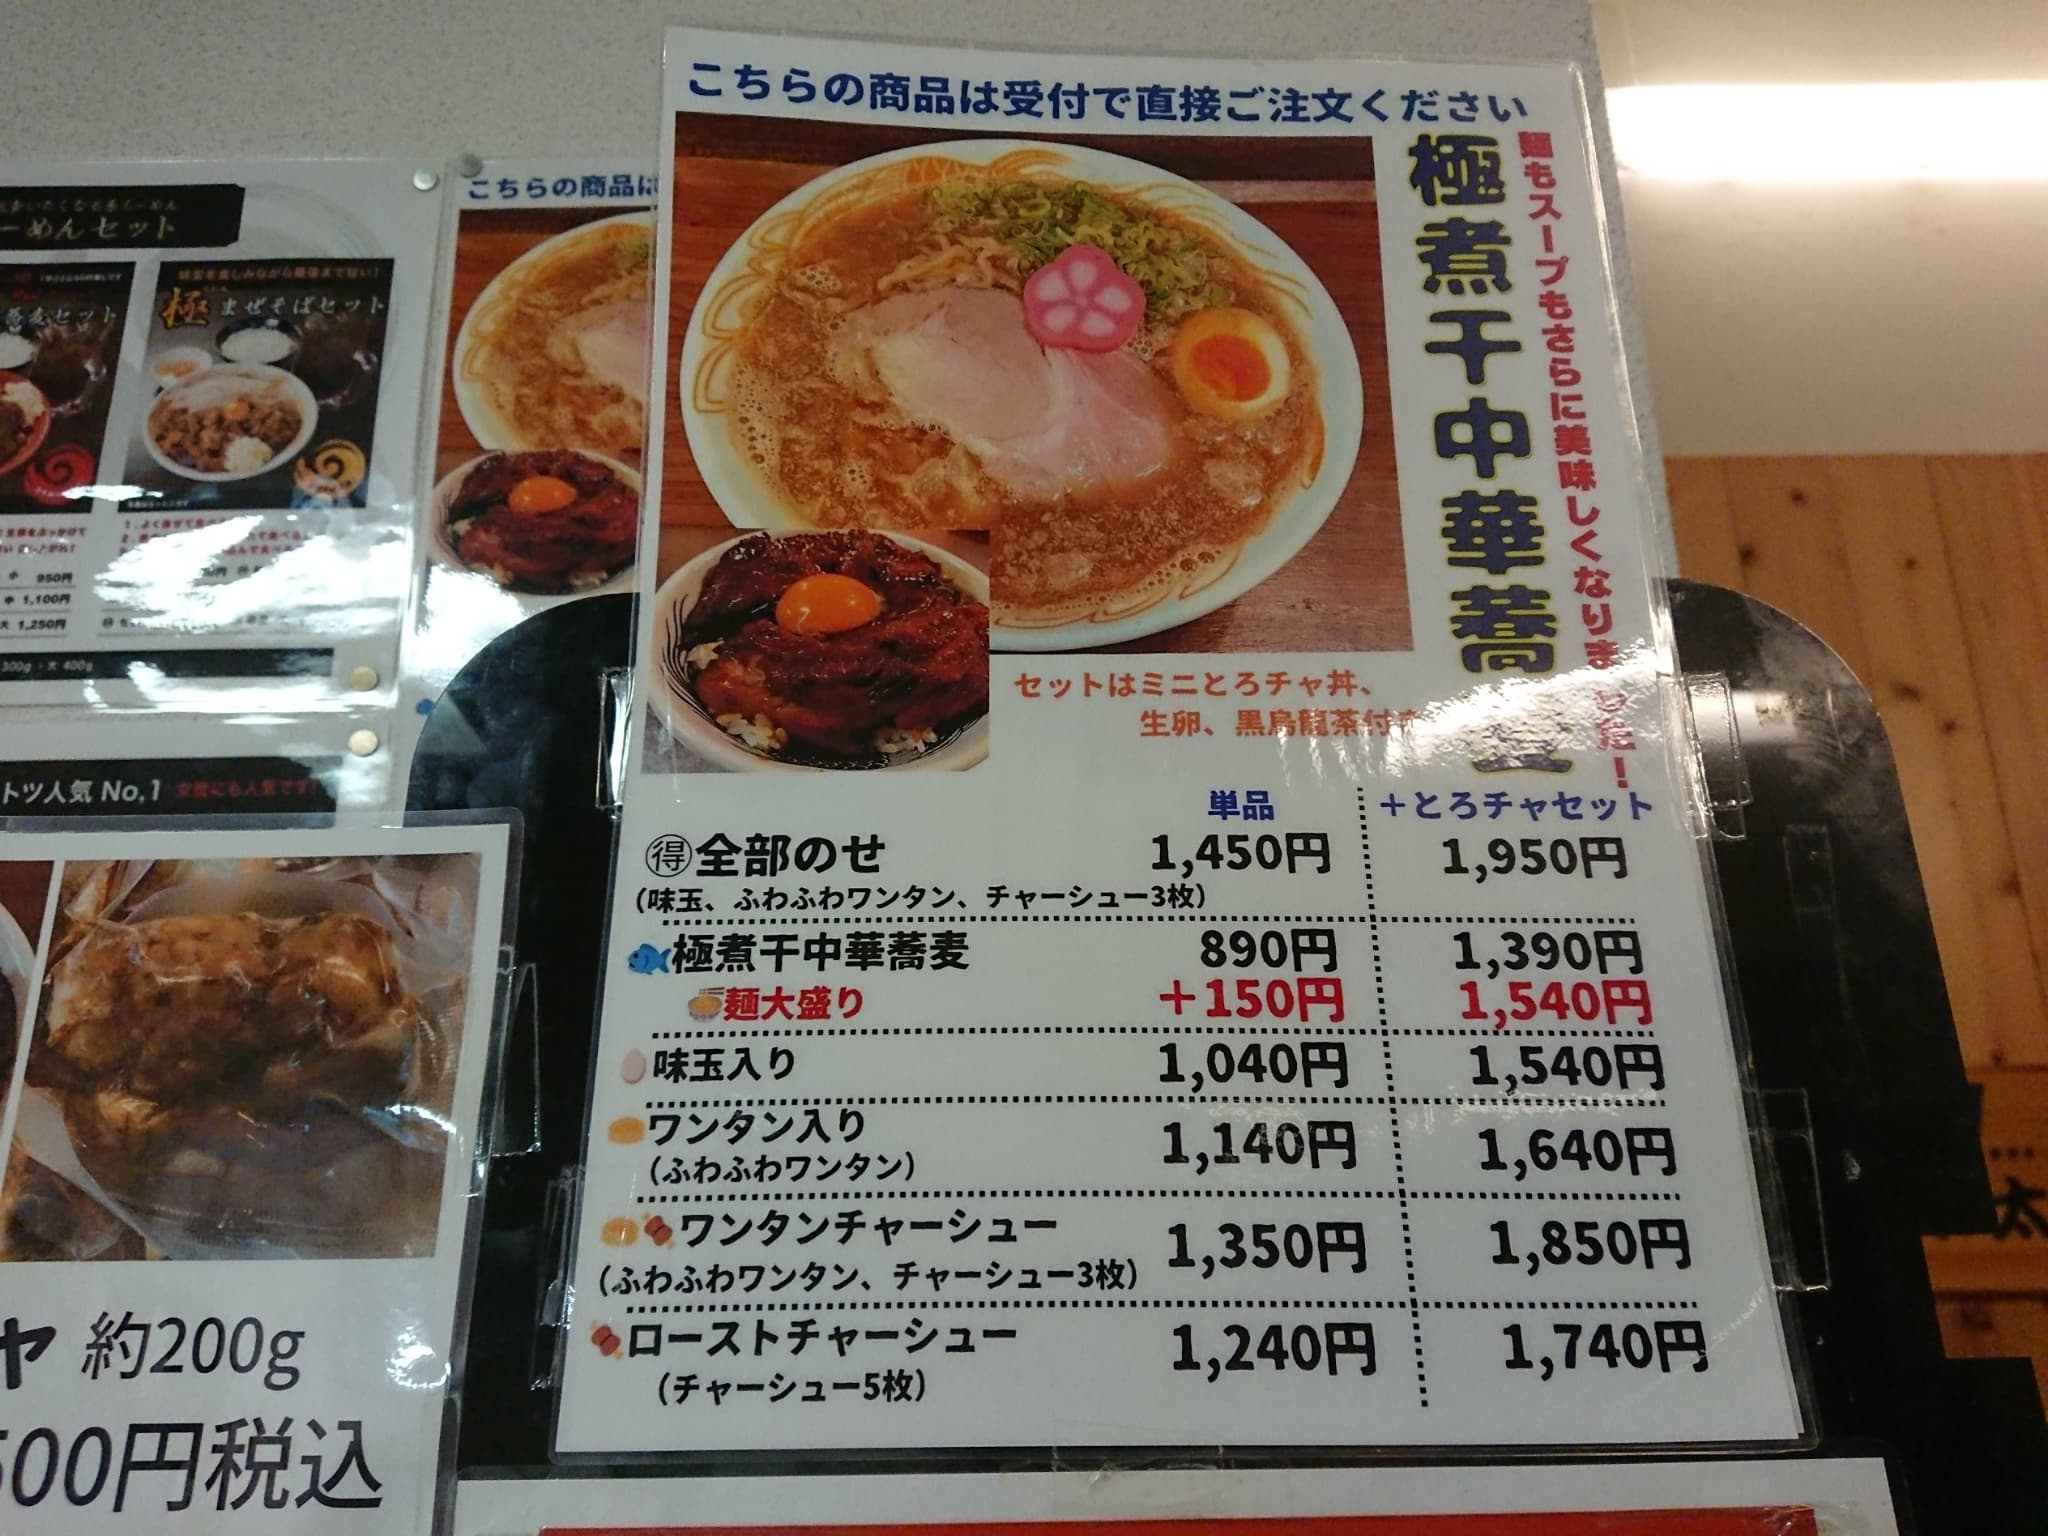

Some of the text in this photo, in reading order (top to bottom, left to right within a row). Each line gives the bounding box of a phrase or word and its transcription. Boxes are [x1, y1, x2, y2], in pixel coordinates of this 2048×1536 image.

[688, 58, 1528, 124] こちらの商品は受付で直接ご注文ください
[18, 619, 66, 631] 1,250円
[23, 593, 70, 606] 1,100円
[1013, 669, 1372, 698] セットはミニとろチャ丼、
[101, 779, 160, 804] No.1
[1208, 790, 1275, 821] 単品
[695, 833, 886, 877] 全部のせ
[1151, 832, 1331, 879] 1,450円
[1442, 836, 1628, 883] 1,950円
[672, 928, 1645, 978] 極煮干中華蕎麦 890円 1,390円
[723, 977, 1653, 1029] 麺大盛り +150円 1,540円
[653, 1041, 1665, 1096] 味玉入り 1,040円 1,540円
[648, 1108, 1677, 1181] ワンタン入り 1,140円 1,640円
[680, 1208, 1692, 1278] ワンタンチャーシュー 1,350円 1,850円
[82, 1310, 305, 1391] 約200g
[628, 1318, 1709, 1382] ローストチャーシュー 1,240円 1,740円
[0, 1416, 384, 1513] 00円税込
